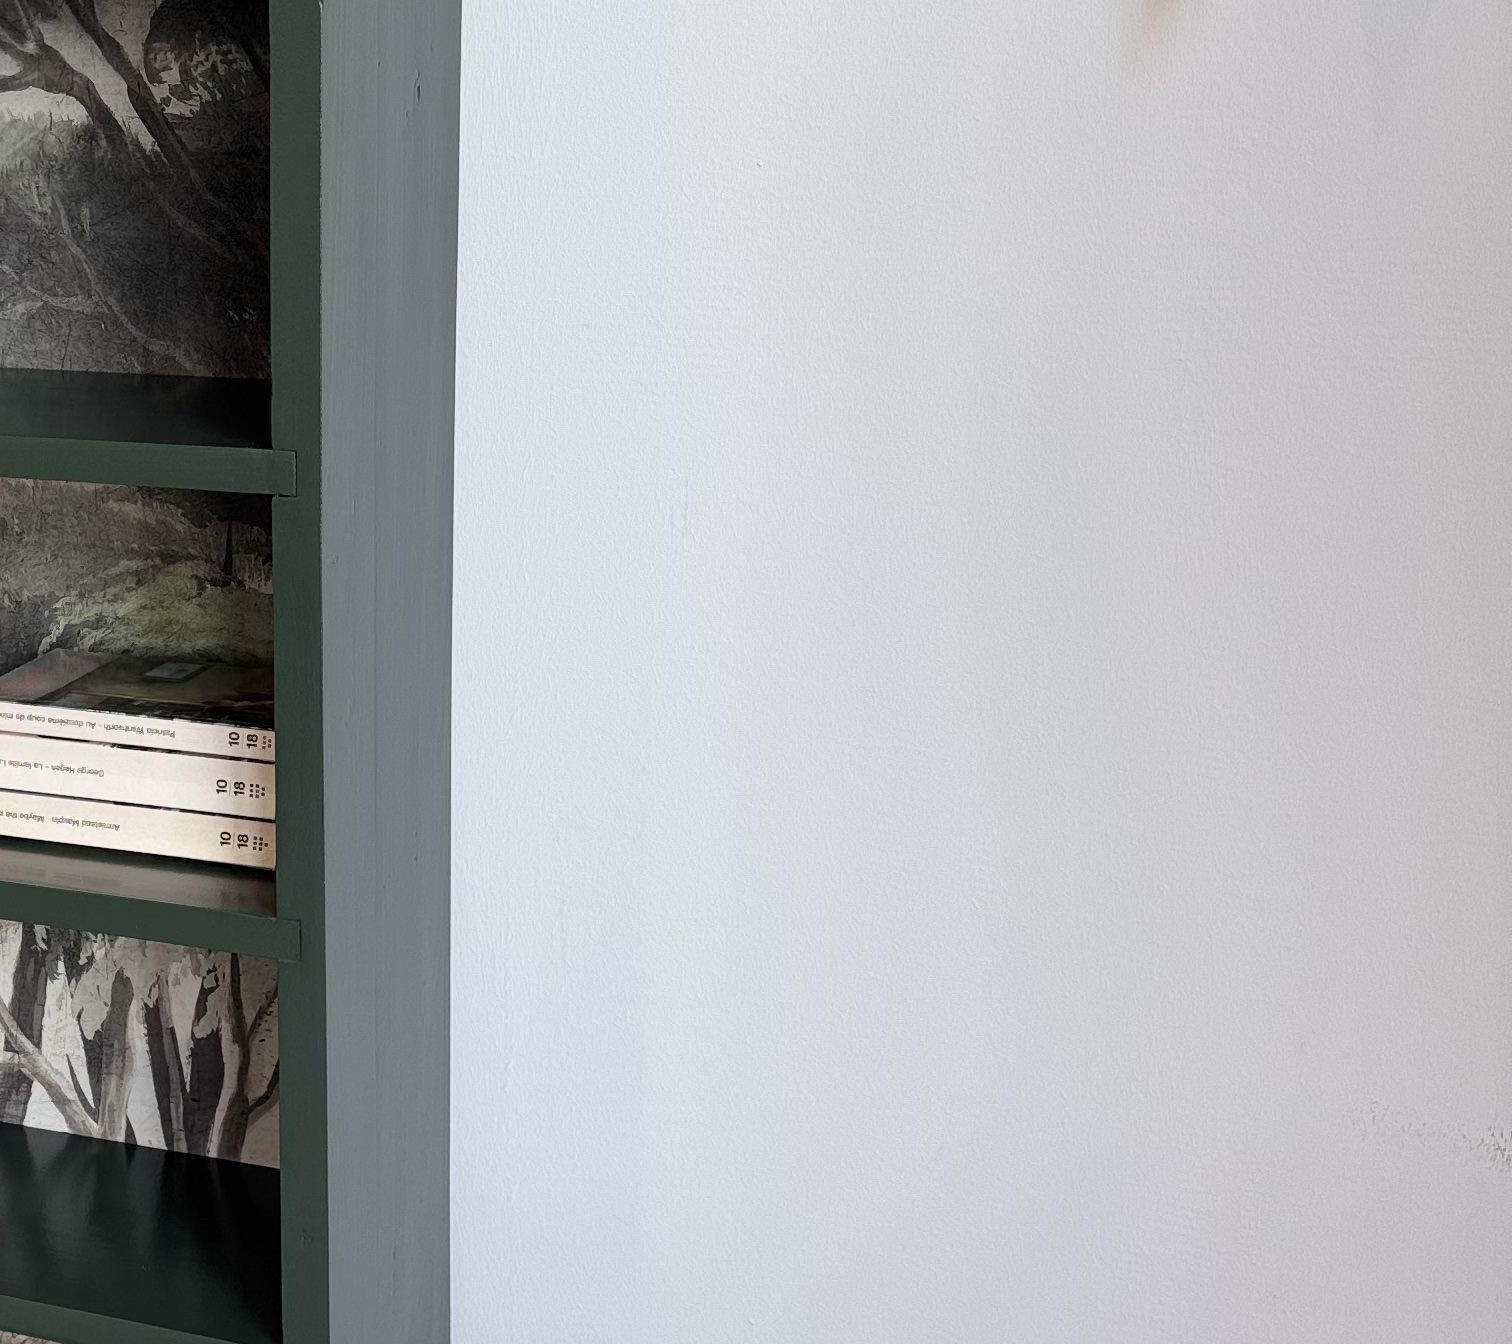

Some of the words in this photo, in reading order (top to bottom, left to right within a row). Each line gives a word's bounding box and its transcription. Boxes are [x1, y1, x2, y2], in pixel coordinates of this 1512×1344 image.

[26, 713, 46, 723] coup
[103, 723, 145, 736] Wentworth
[146, 727, 176, 739] Patricia
[228, 732, 240, 746] 10
[246, 734, 258, 749] 18
[50, 763, 76, 774] Hagen
[76, 766, 105, 778] George
[216, 779, 227, 794] 10
[234, 781, 245, 797] 18
[5, 811, 18, 819] the
[19, 812, 45, 824] Maybe
[51, 815, 80, 827] Maupin
[220, 831, 231, 846] 10
[237, 834, 249, 849] 18
